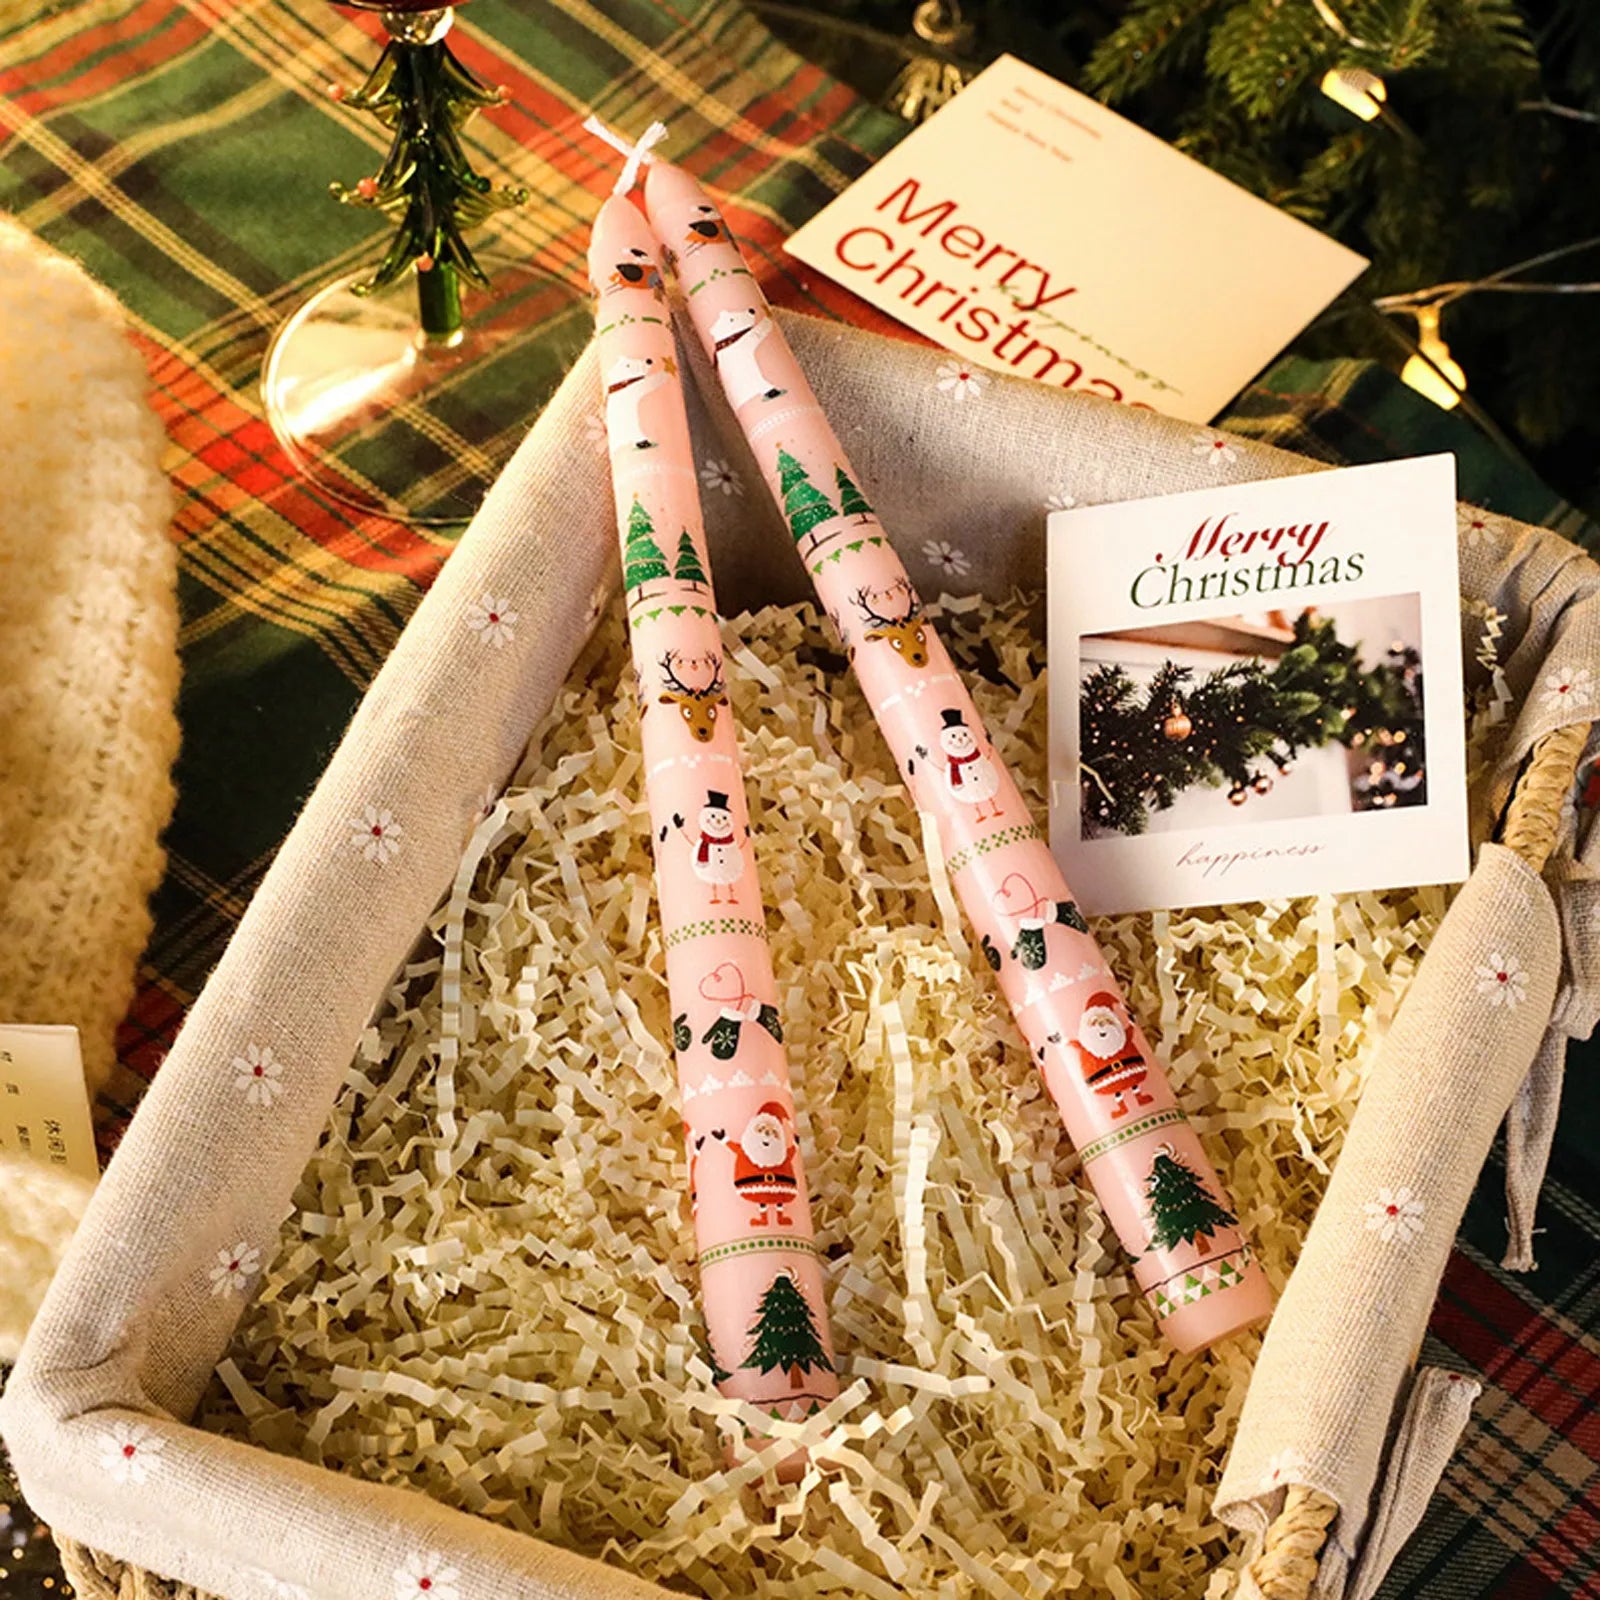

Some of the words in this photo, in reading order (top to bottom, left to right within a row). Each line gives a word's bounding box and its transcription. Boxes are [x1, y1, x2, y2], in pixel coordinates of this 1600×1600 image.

[875, 178, 1078, 312] Merry
[835, 227, 1157, 411] Christma
[1155, 512, 1337, 568] Merry
[1130, 552, 1364, 609] Christmas
[1176, 842, 1326, 878] happiness
